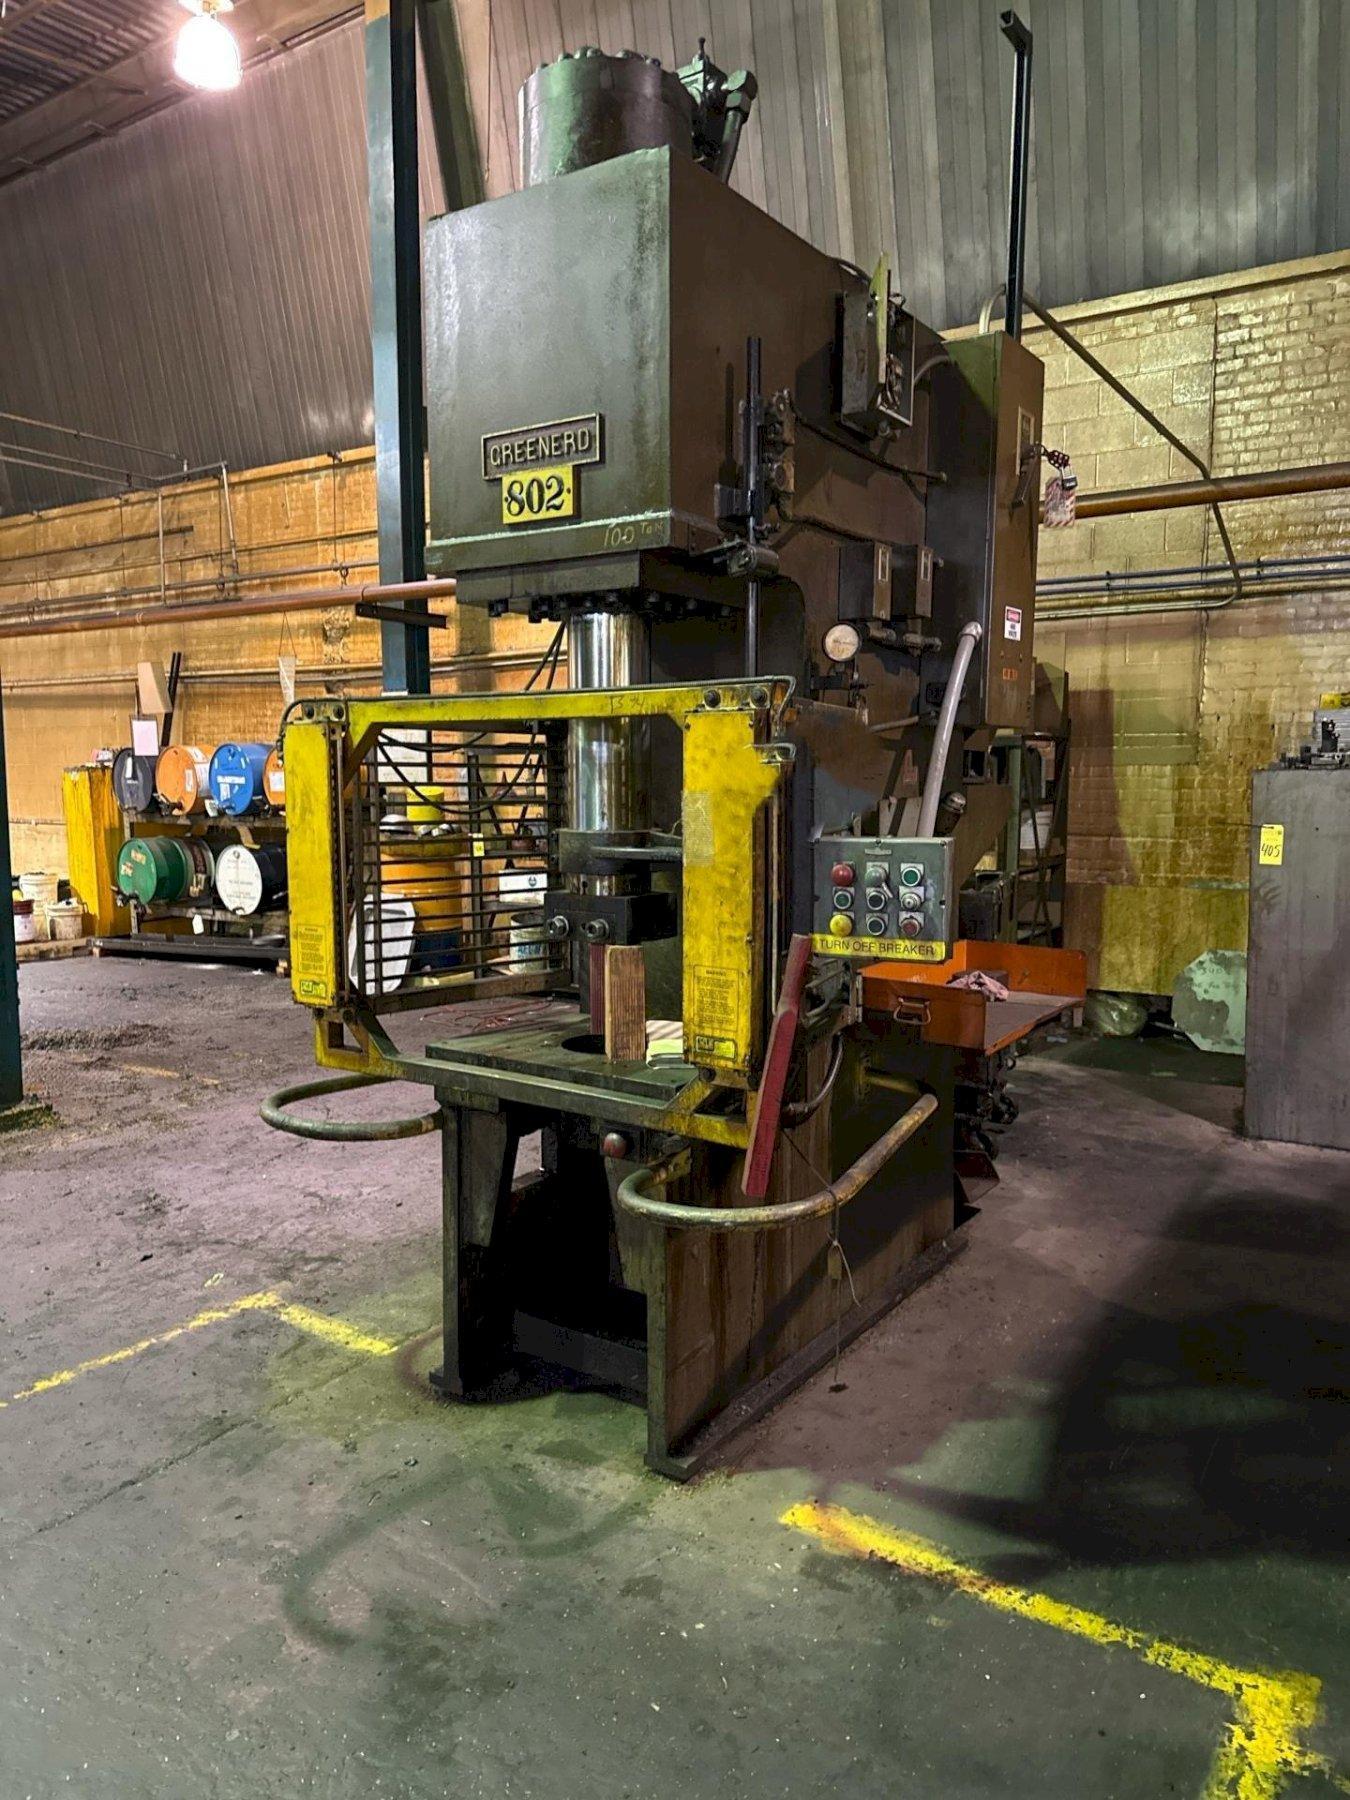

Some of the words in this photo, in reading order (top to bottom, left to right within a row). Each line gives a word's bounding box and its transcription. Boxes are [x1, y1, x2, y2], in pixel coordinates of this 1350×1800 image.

[490, 427, 590, 467] GREENERD
[506, 475, 565, 517] 802
[603, 524, 636, 548] 100
[1261, 843, 1281, 858] 405
[820, 938, 850, 950] TURN
[852, 940, 875, 952] OFF
[878, 942, 935, 956] BREAKER
